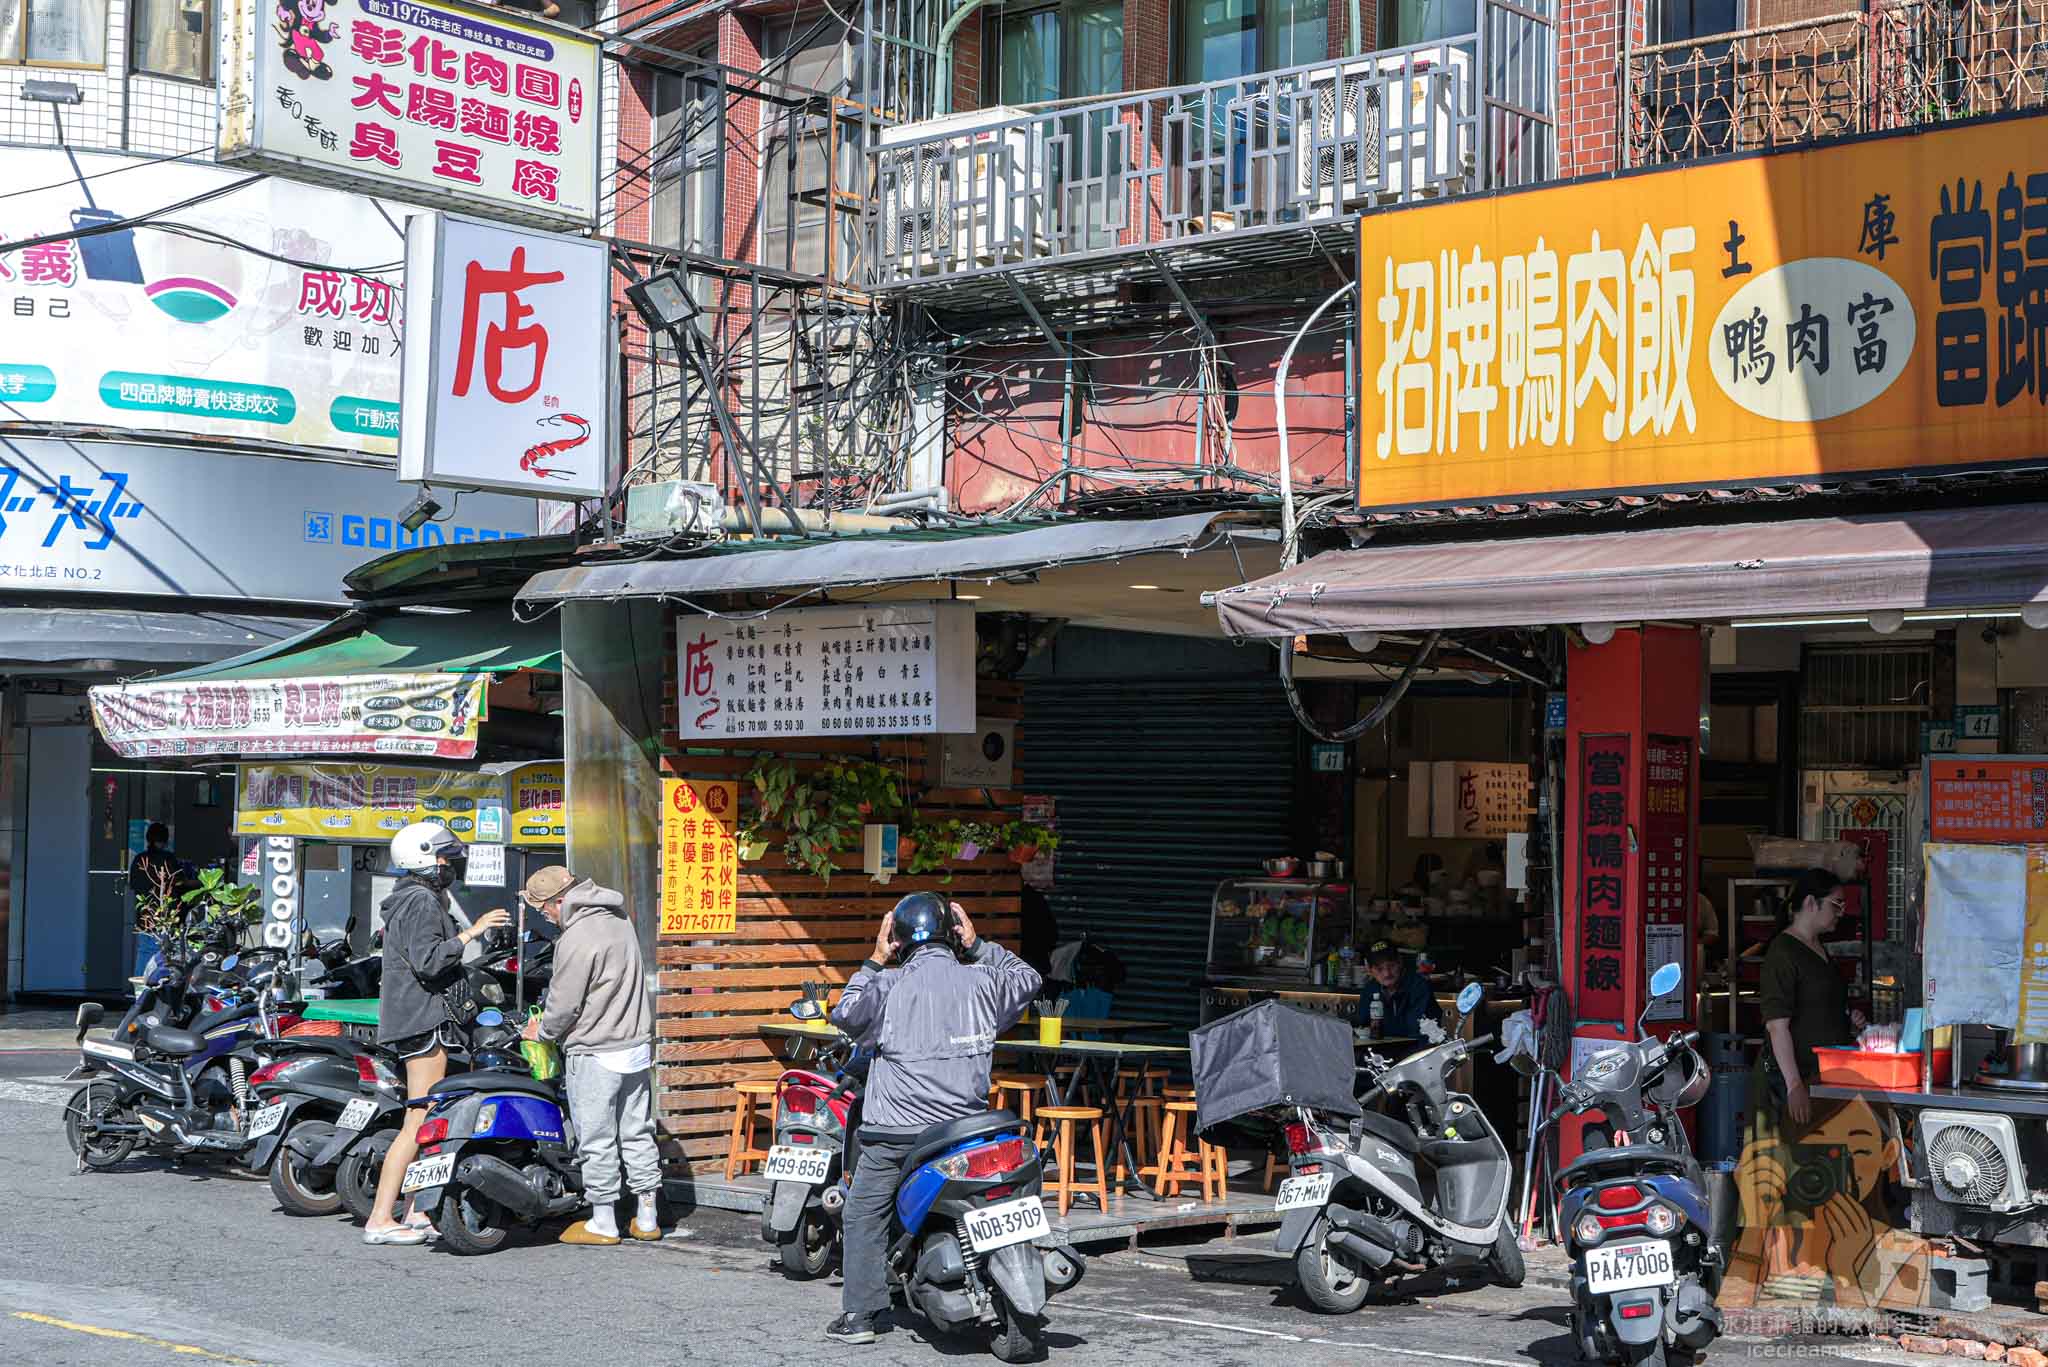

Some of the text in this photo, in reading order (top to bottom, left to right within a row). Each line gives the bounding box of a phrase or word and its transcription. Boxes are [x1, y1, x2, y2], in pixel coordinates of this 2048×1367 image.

[350, 19, 562, 110] 彰化肉圓
[350, 73, 563, 155] 大腸麵線
[349, 121, 561, 203] 臭豆腐
[298, 271, 403, 324] 成功
[14, 296, 71, 318] 自己
[452, 246, 564, 404] 店
[1376, 222, 1696, 460] 招牌鴨肉飯
[1723, 291, 1895, 385] 鴨肉富
[64, 567, 102, 580] NO.2
[738, 720, 745, 732] 15
[747, 720, 756, 731] 70
[757, 720, 767, 731] 100
[773, 720, 782, 731] 50
[784, 720, 793, 731] 50
[795, 720, 804, 731] 30
[832, 718, 841, 729] 60
[844, 718, 852, 729] 60
[855, 717, 863, 729] 60
[866, 717, 875, 728] 60
[877, 716, 886, 728] 35
[888, 716, 897, 728] 35
[900, 716, 908, 727] 35
[912, 715, 920, 726] 15
[924, 715, 932, 726] 15
[700, 818, 715, 910] 年齡不拘
[718, 819, 733, 910] 工作伙伴
[1585, 750, 1625, 992] 當歸鴨肉麵線
[667, 914, 732, 931] 2977-6777
[767, 1156, 827, 1178] M99-856
[404, 1164, 450, 1187] 276-KNK
[970, 1207, 1041, 1242] NDB-3909
[1590, 1252, 1669, 1283] PAA-7008
